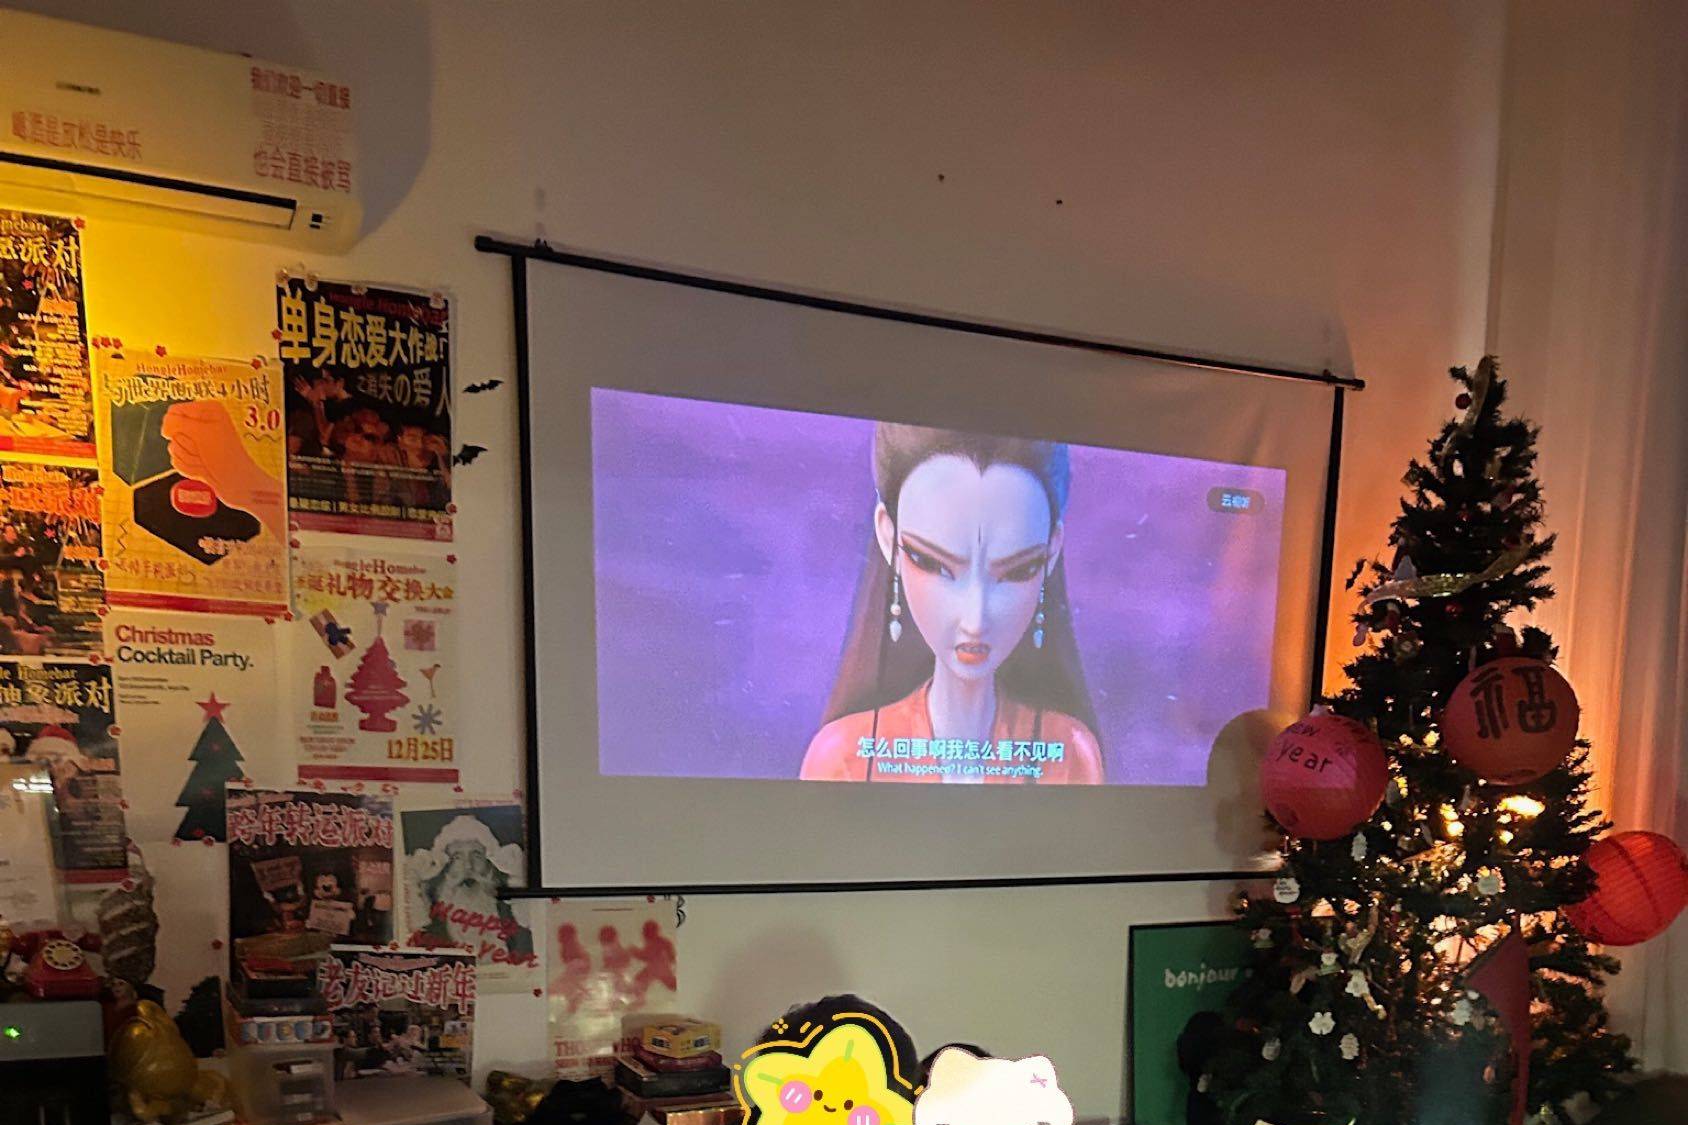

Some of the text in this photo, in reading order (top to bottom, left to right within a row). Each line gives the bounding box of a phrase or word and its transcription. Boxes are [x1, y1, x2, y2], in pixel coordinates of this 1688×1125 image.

[244, 405, 281, 431] 3.0
[115, 624, 216, 646] Christmas
[117, 645, 254, 671] Cocktail Party.
[1470, 665, 1558, 740] 福
[387, 736, 454, 762] 12月25日
[856, 736, 1065, 762] 怎么回事啊我怎么看不见啊
[877, 762, 903, 775] What
[904, 762, 955, 776] happened?
[963, 764, 985, 776] can't
[986, 767, 1001, 776] see
[1002, 765, 1044, 779] anything.
[429, 900, 518, 941] Happy
[317, 954, 477, 1015] 老友记过新年
[1163, 962, 1239, 991] bonjour
